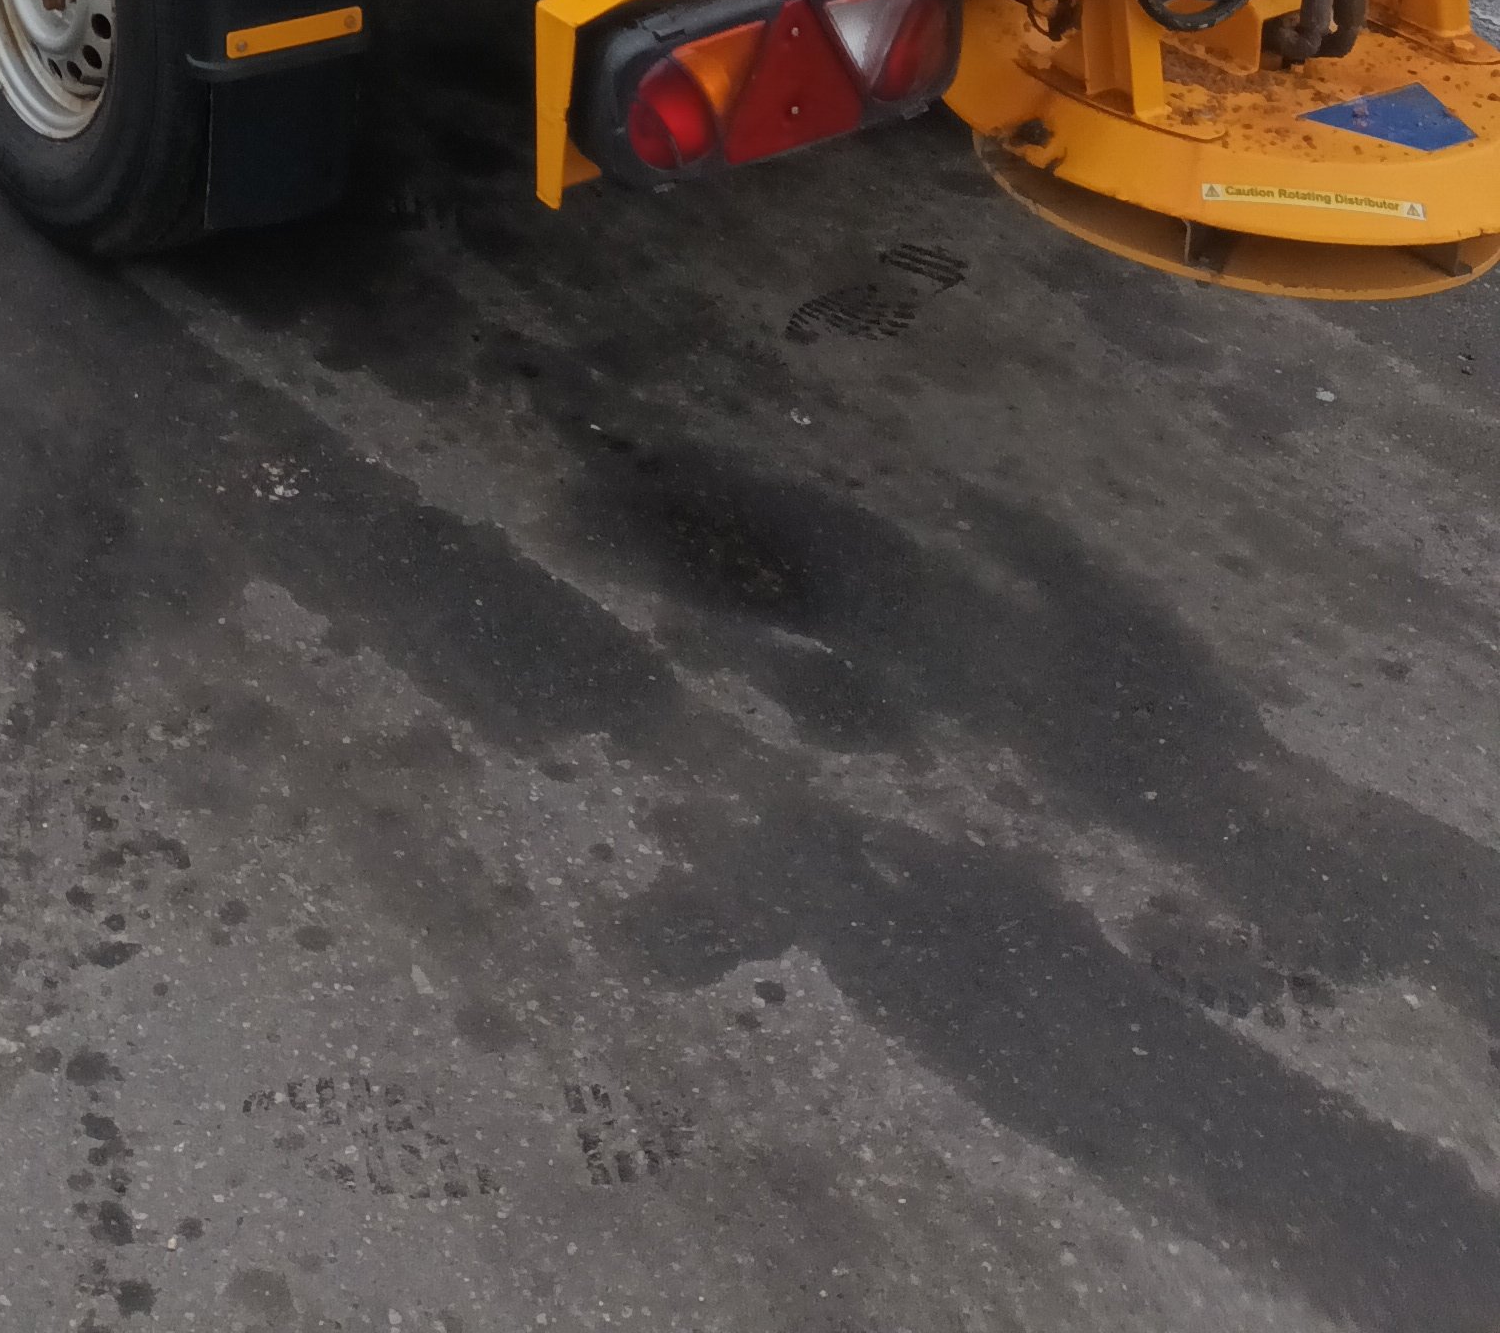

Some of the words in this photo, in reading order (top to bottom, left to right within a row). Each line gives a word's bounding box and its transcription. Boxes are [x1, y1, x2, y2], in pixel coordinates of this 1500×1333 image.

[1224, 185, 1275, 199] Caution
[1278, 188, 1332, 205] Rotating
[1335, 193, 1400, 211] Distributor
